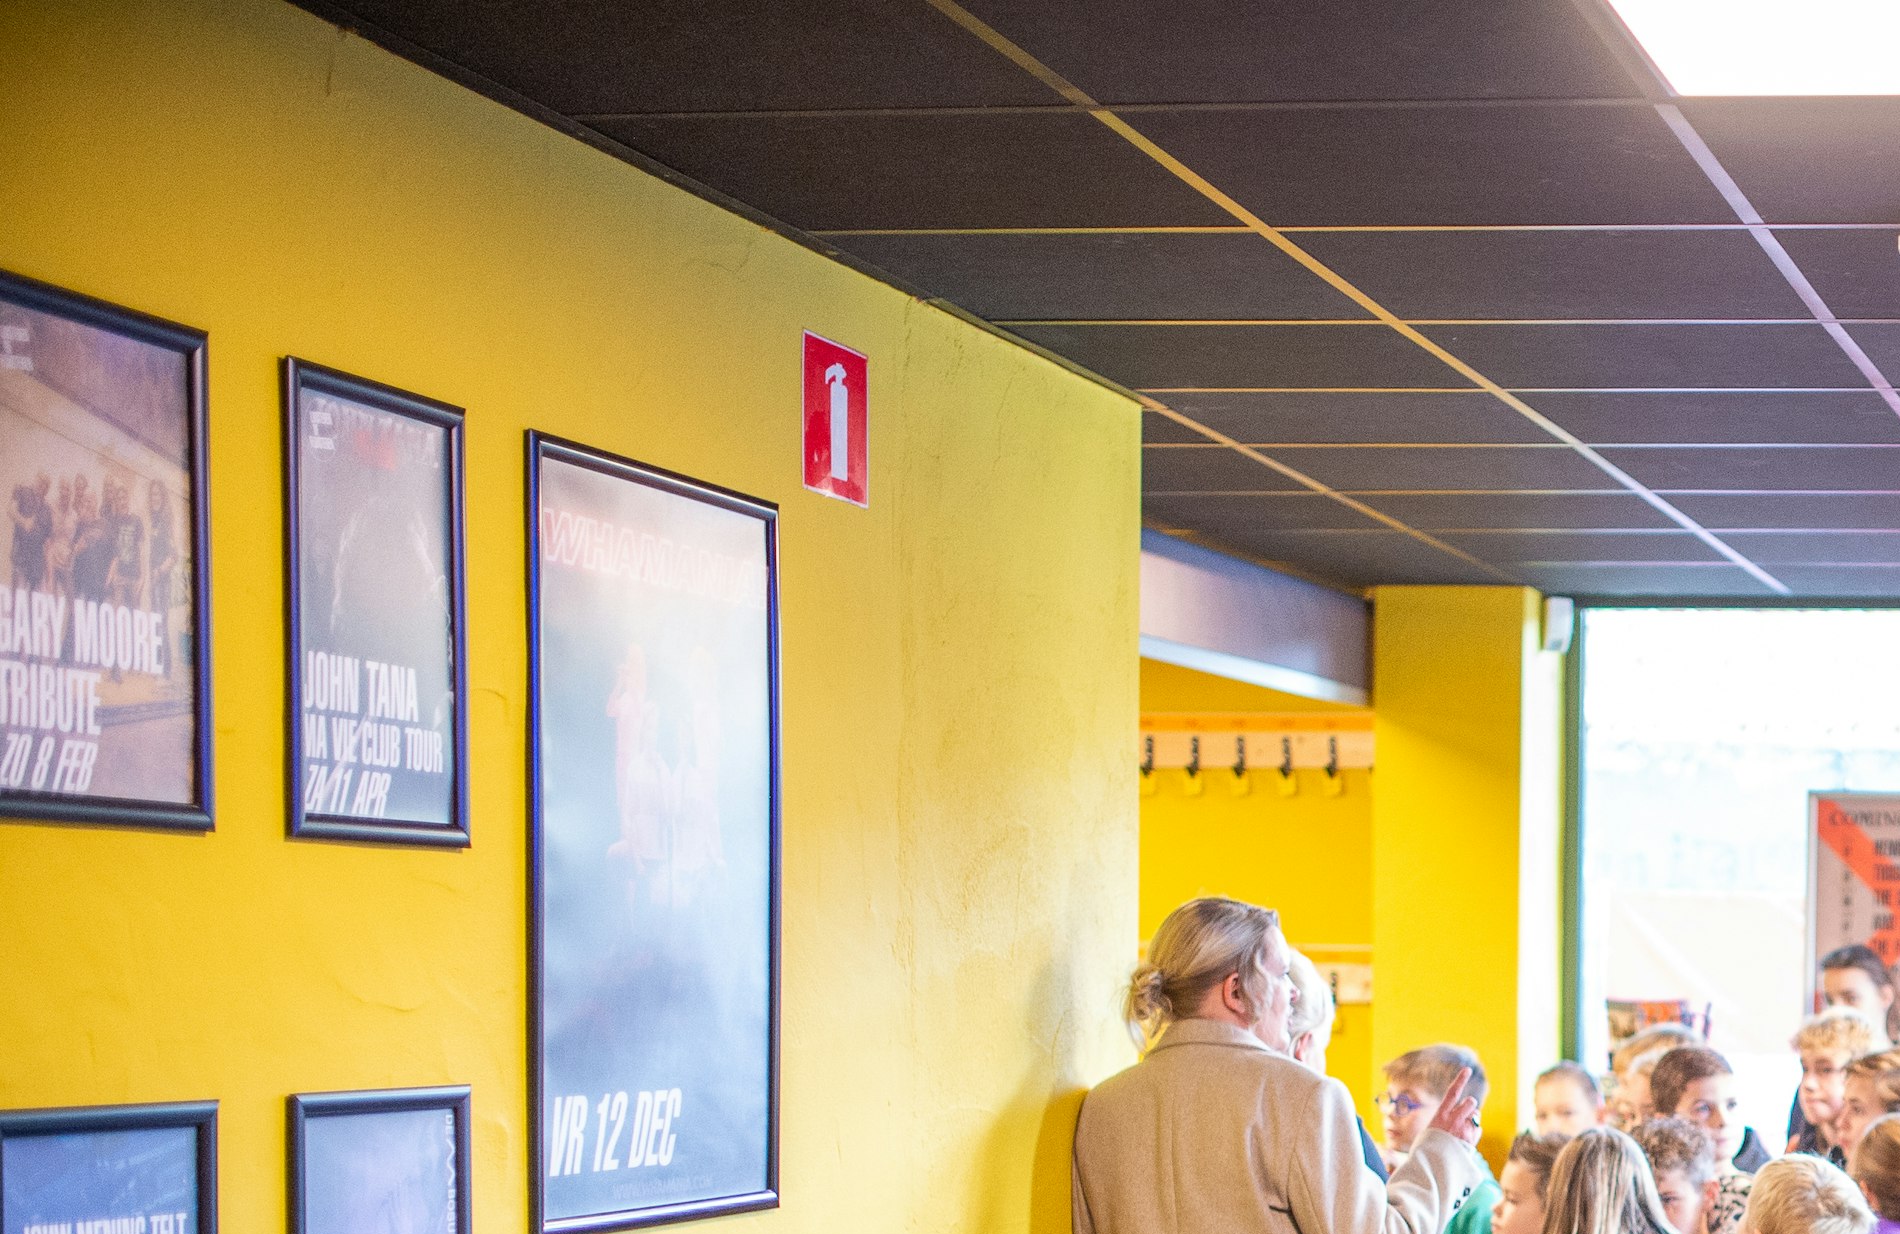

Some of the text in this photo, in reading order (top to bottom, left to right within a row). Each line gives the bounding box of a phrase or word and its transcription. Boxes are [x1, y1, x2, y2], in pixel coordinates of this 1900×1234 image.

[73, 597, 164, 675] MOORE
[304, 650, 419, 723] JOHN TANA
[31, 735, 56, 792] 8
[52, 739, 99, 793] FEB
[361, 721, 401, 769] CLUB
[404, 727, 444, 774] TOUR
[303, 764, 392, 818] ZA 11 APR
[549, 1087, 683, 1177] VR 12 DEC
